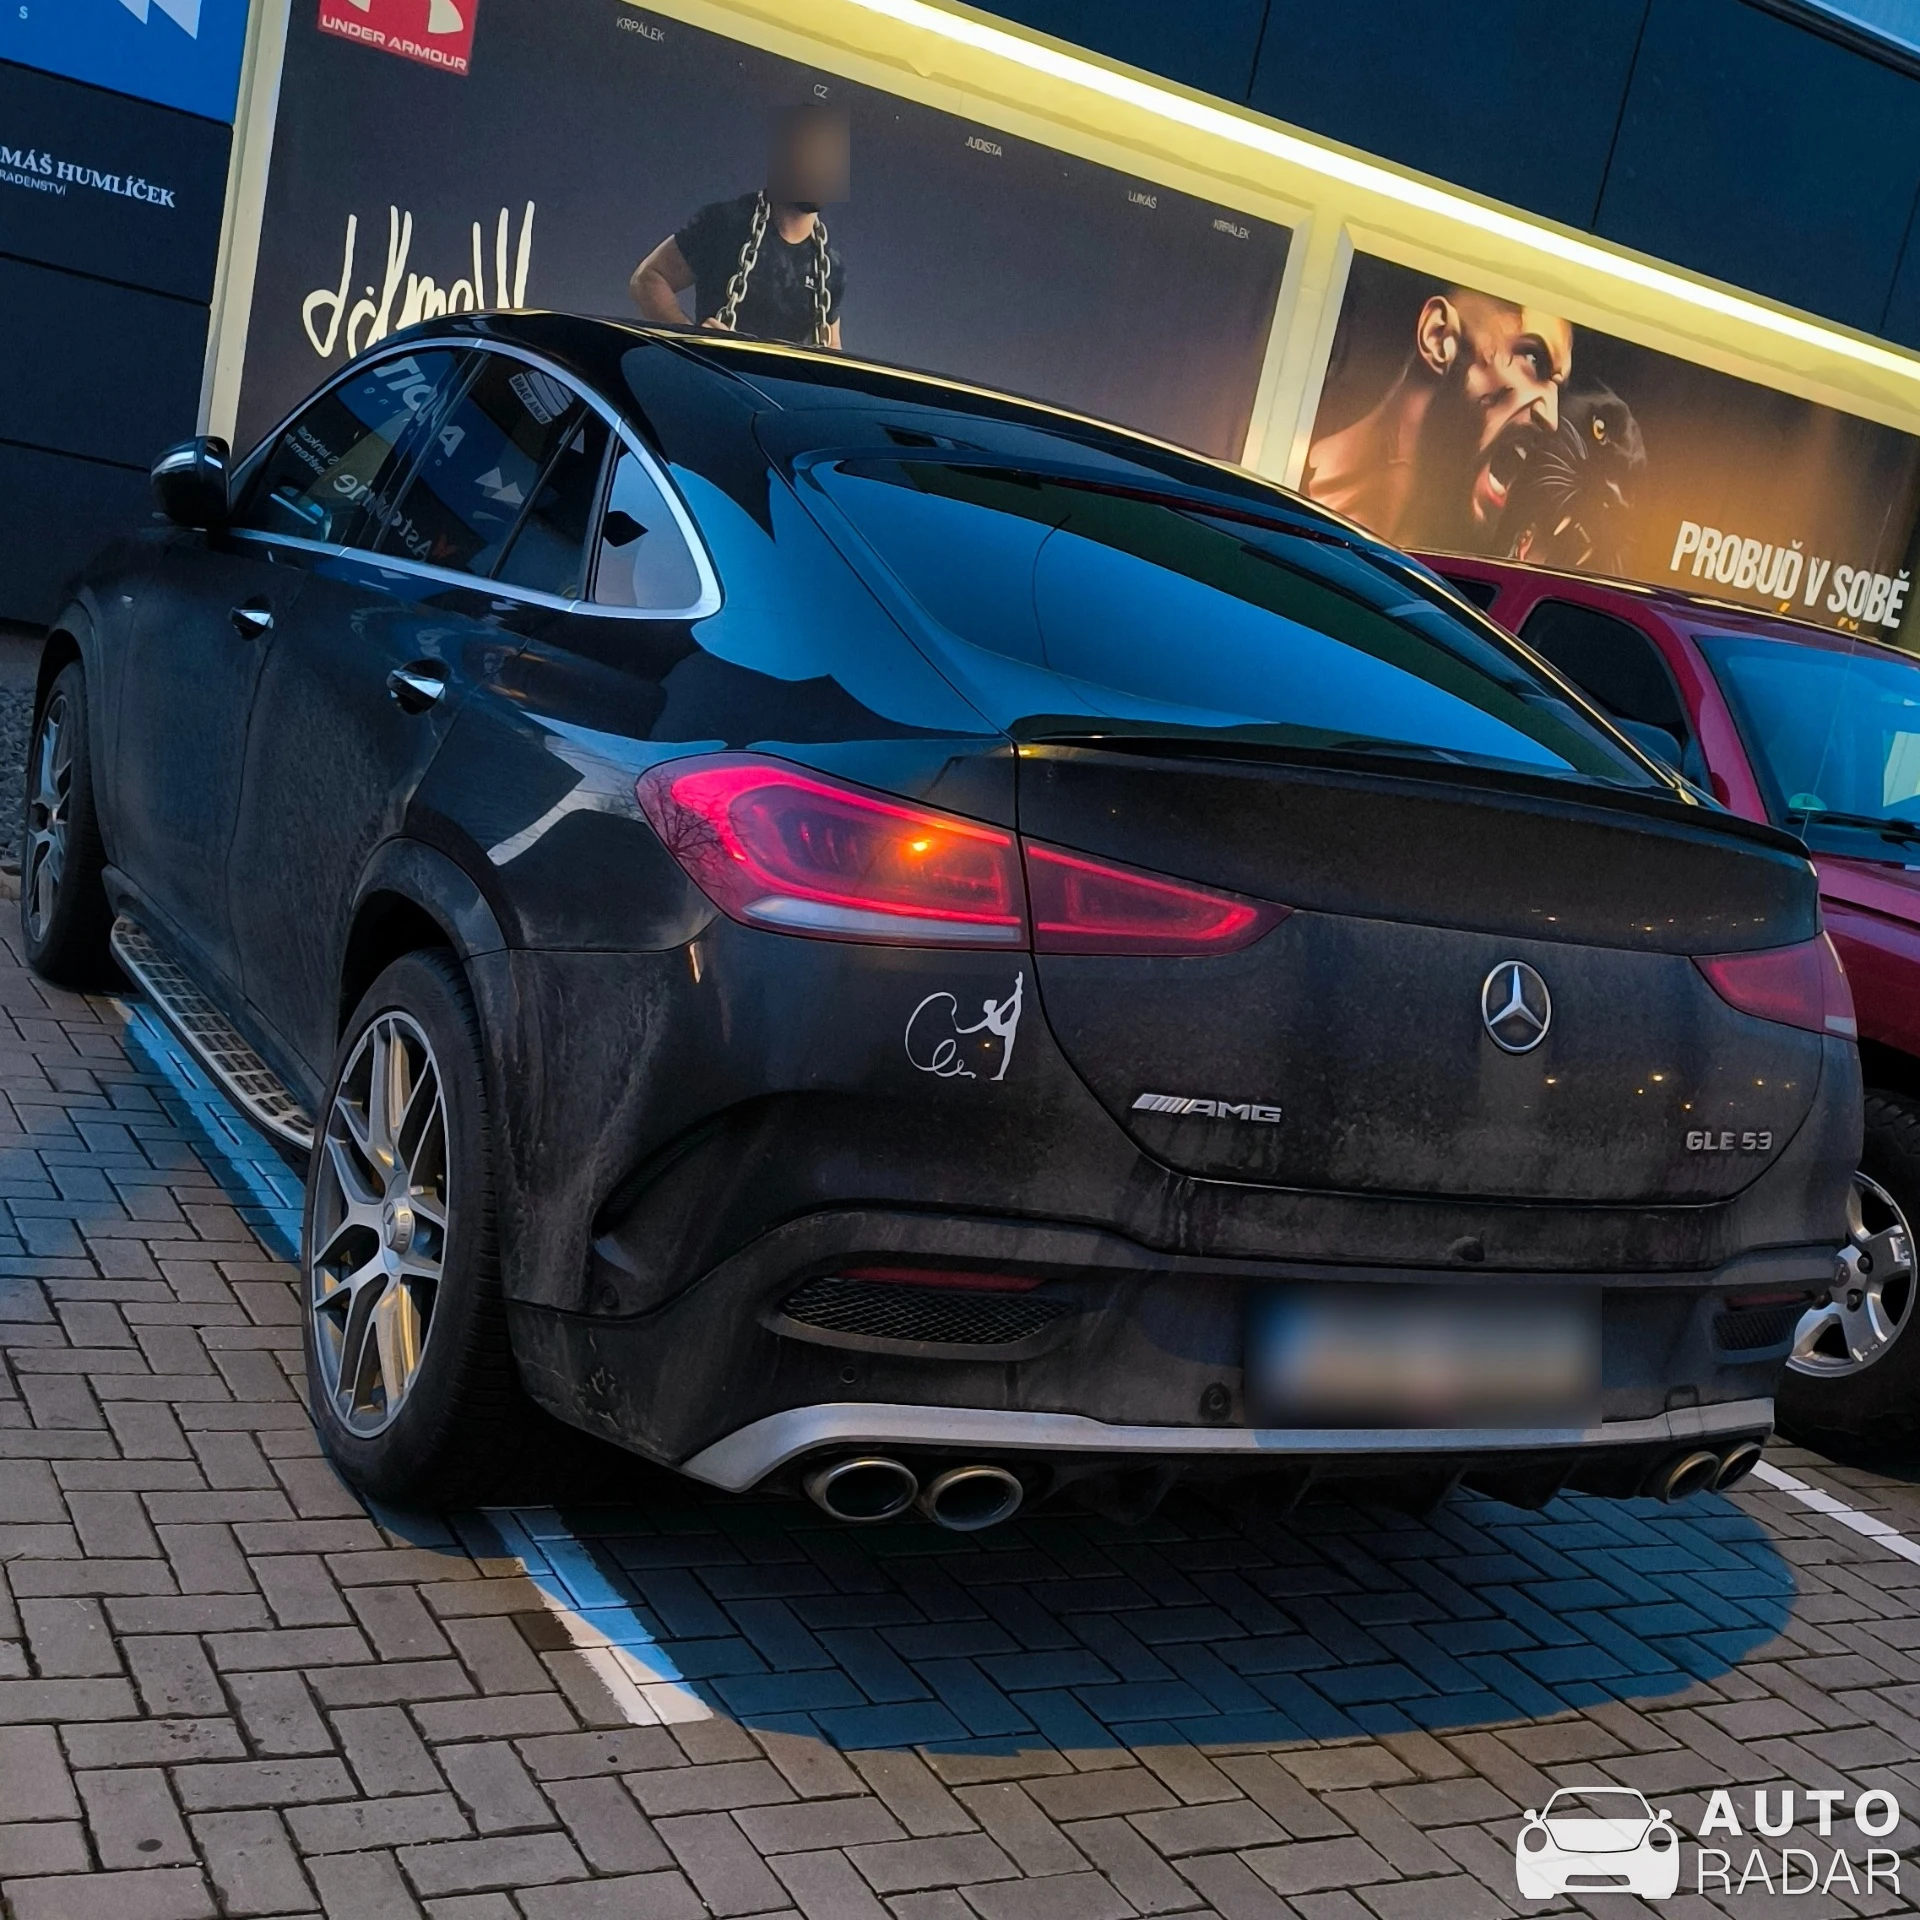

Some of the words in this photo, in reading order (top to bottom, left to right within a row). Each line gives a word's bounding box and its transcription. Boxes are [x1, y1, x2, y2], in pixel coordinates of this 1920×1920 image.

[322, 15, 386, 44] UNDER
[388, 37, 467, 70] ARMOUR
[0, 146, 52, 175] MÁŠ
[56, 161, 175, 208] HUMLÍČEK
[1670, 521, 1803, 599] PROBUĎ
[1804, 557, 1831, 606] V
[1827, 569, 1910, 629] SOBĚ
[1180, 1098, 1282, 1123] AMG
[1686, 1131, 1736, 1150] GLE
[1741, 1131, 1773, 1150] 53
